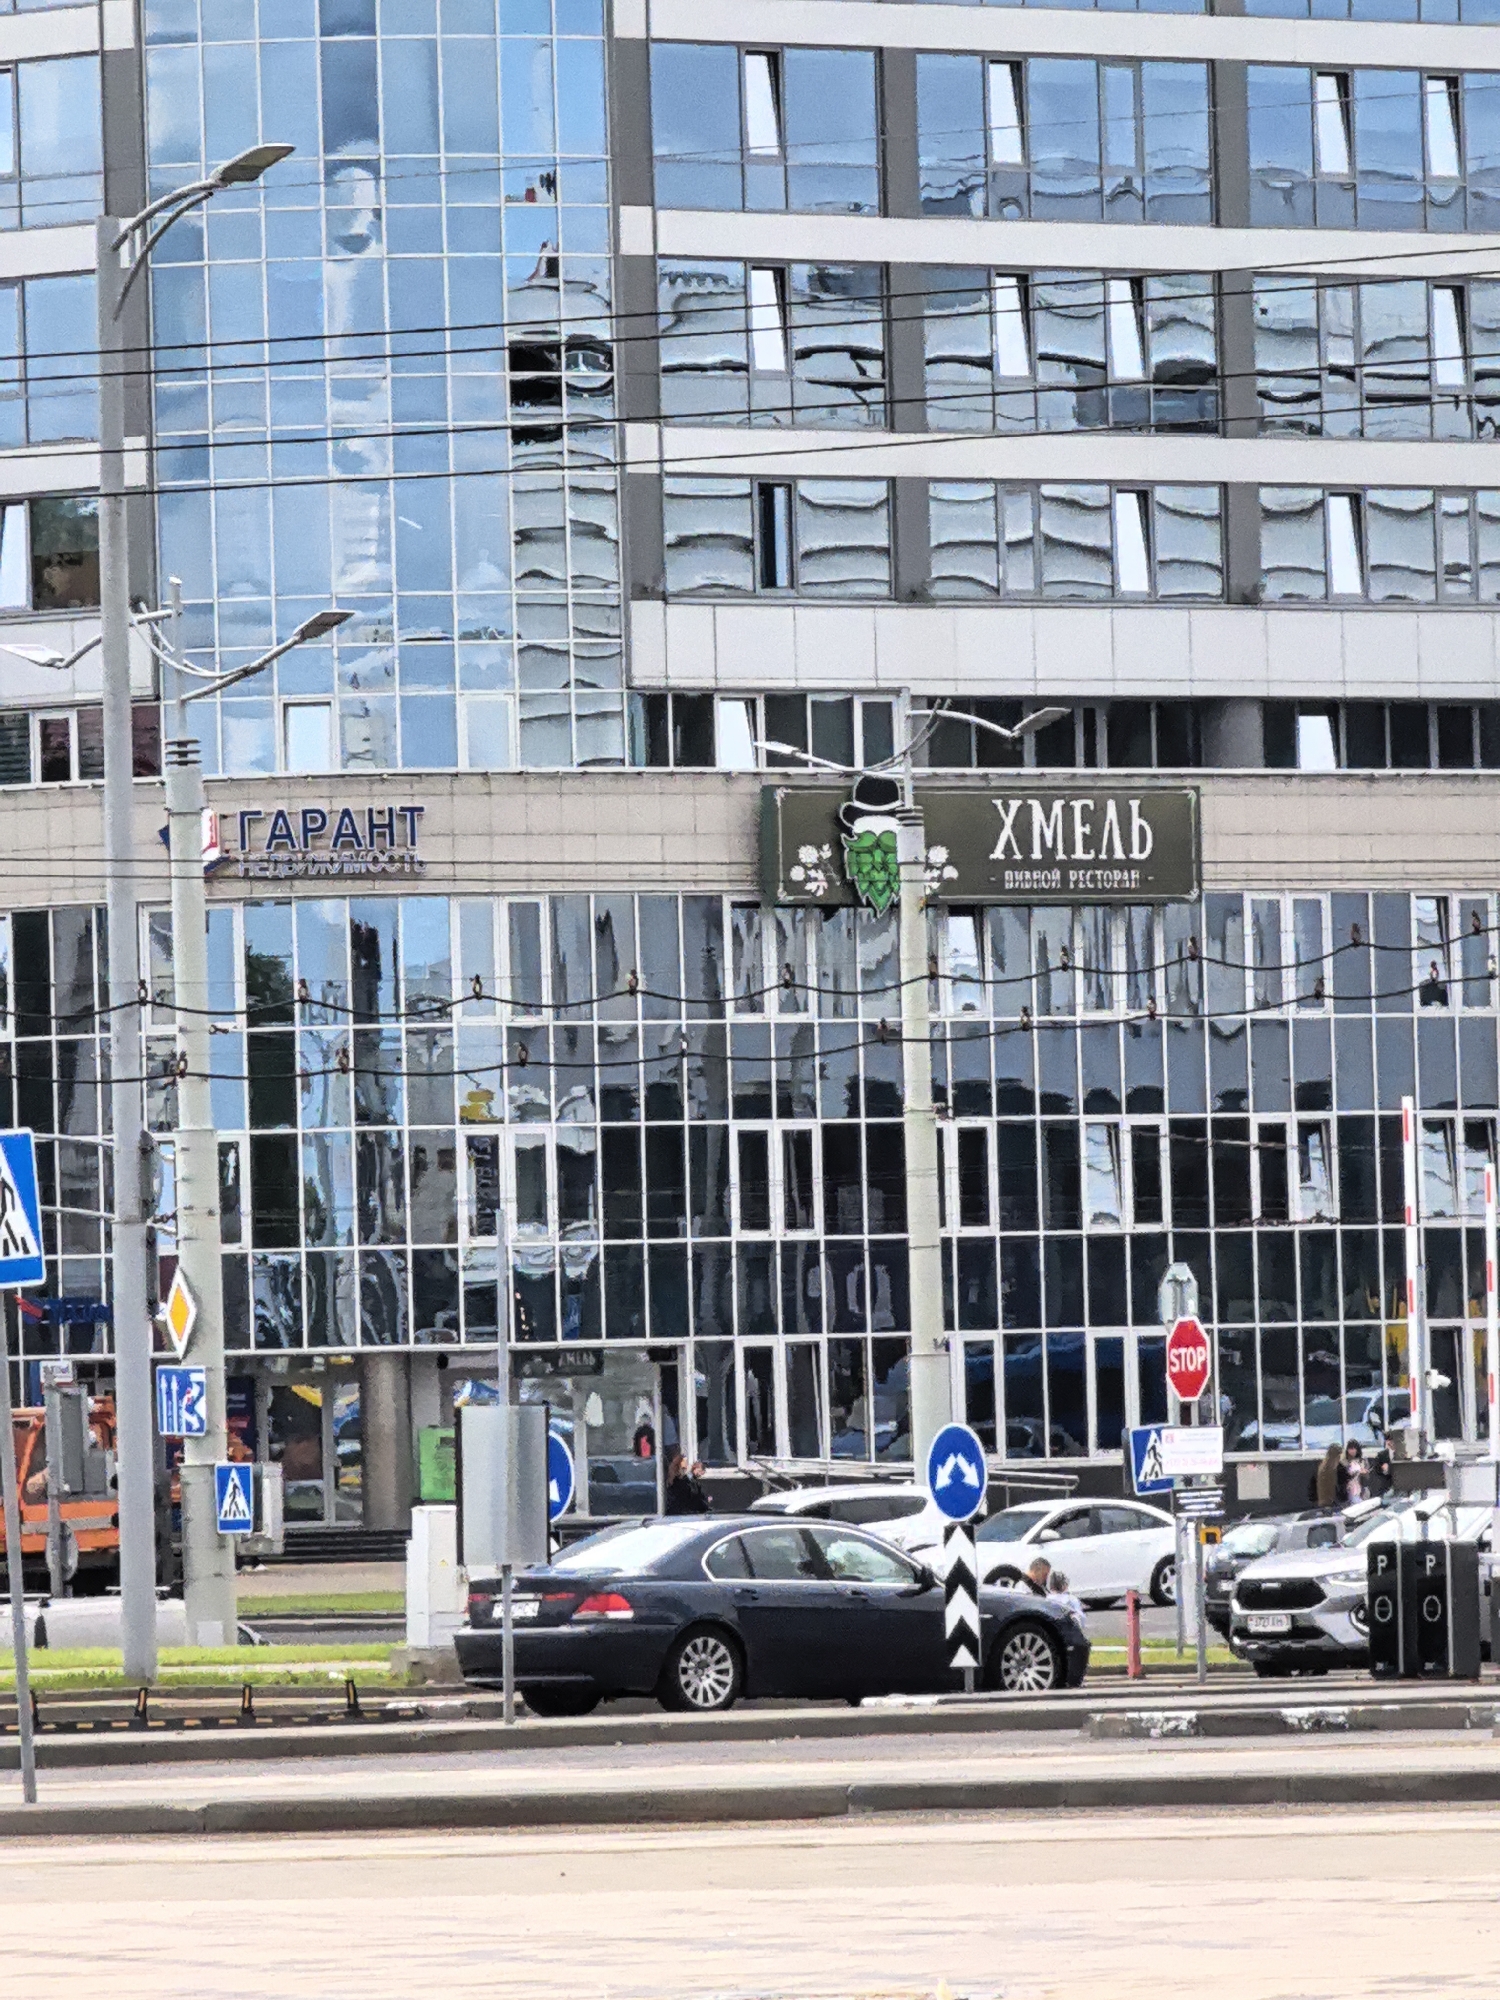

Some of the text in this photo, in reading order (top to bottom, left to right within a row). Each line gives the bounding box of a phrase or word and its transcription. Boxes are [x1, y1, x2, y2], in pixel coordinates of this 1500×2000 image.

[238, 806, 426, 852] ГАРАНТ
[989, 798, 1153, 861] ХМЕЛЬ
[1004, 868, 1141, 889] ПИВНОЙ РЕСТОРАН
[1170, 1347, 1206, 1373] STOP
